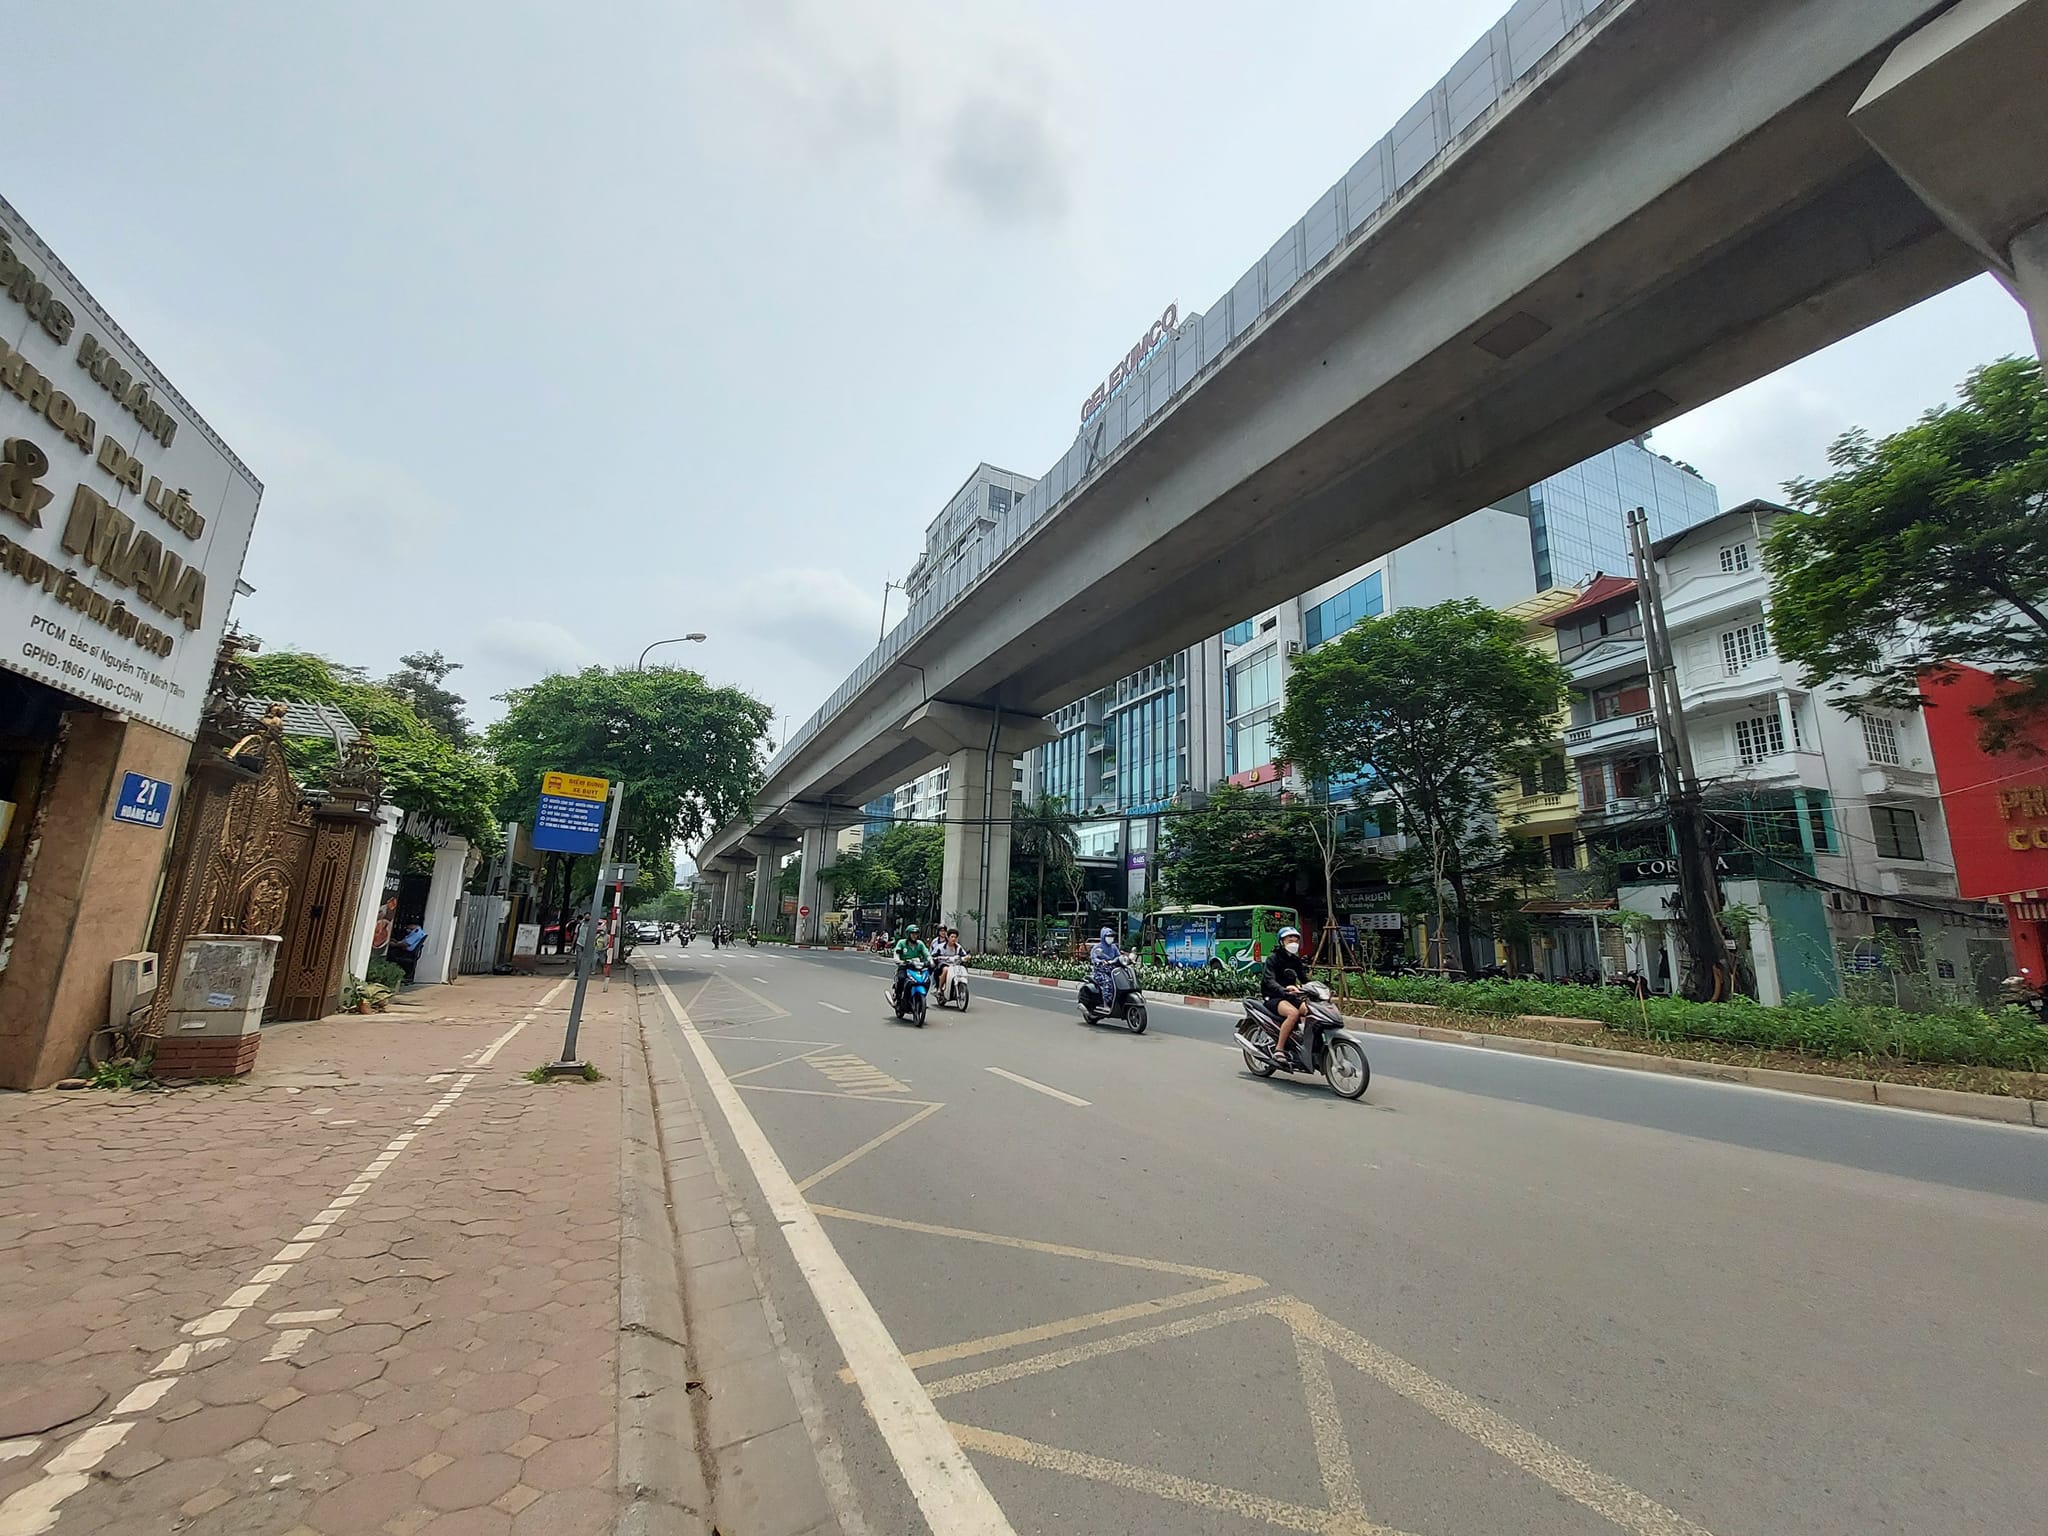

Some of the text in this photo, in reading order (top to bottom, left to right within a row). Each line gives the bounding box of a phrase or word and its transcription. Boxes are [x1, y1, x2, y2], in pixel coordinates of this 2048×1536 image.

[0, 438, 55, 529] &
[97, 434, 144, 495] DA
[30, 615, 66, 642] PTCM
[69, 634, 89, 654] Bác
[100, 649, 134, 679] Nguyễn
[135, 621, 174, 659] CAO
[135, 779, 158, 806] 21
